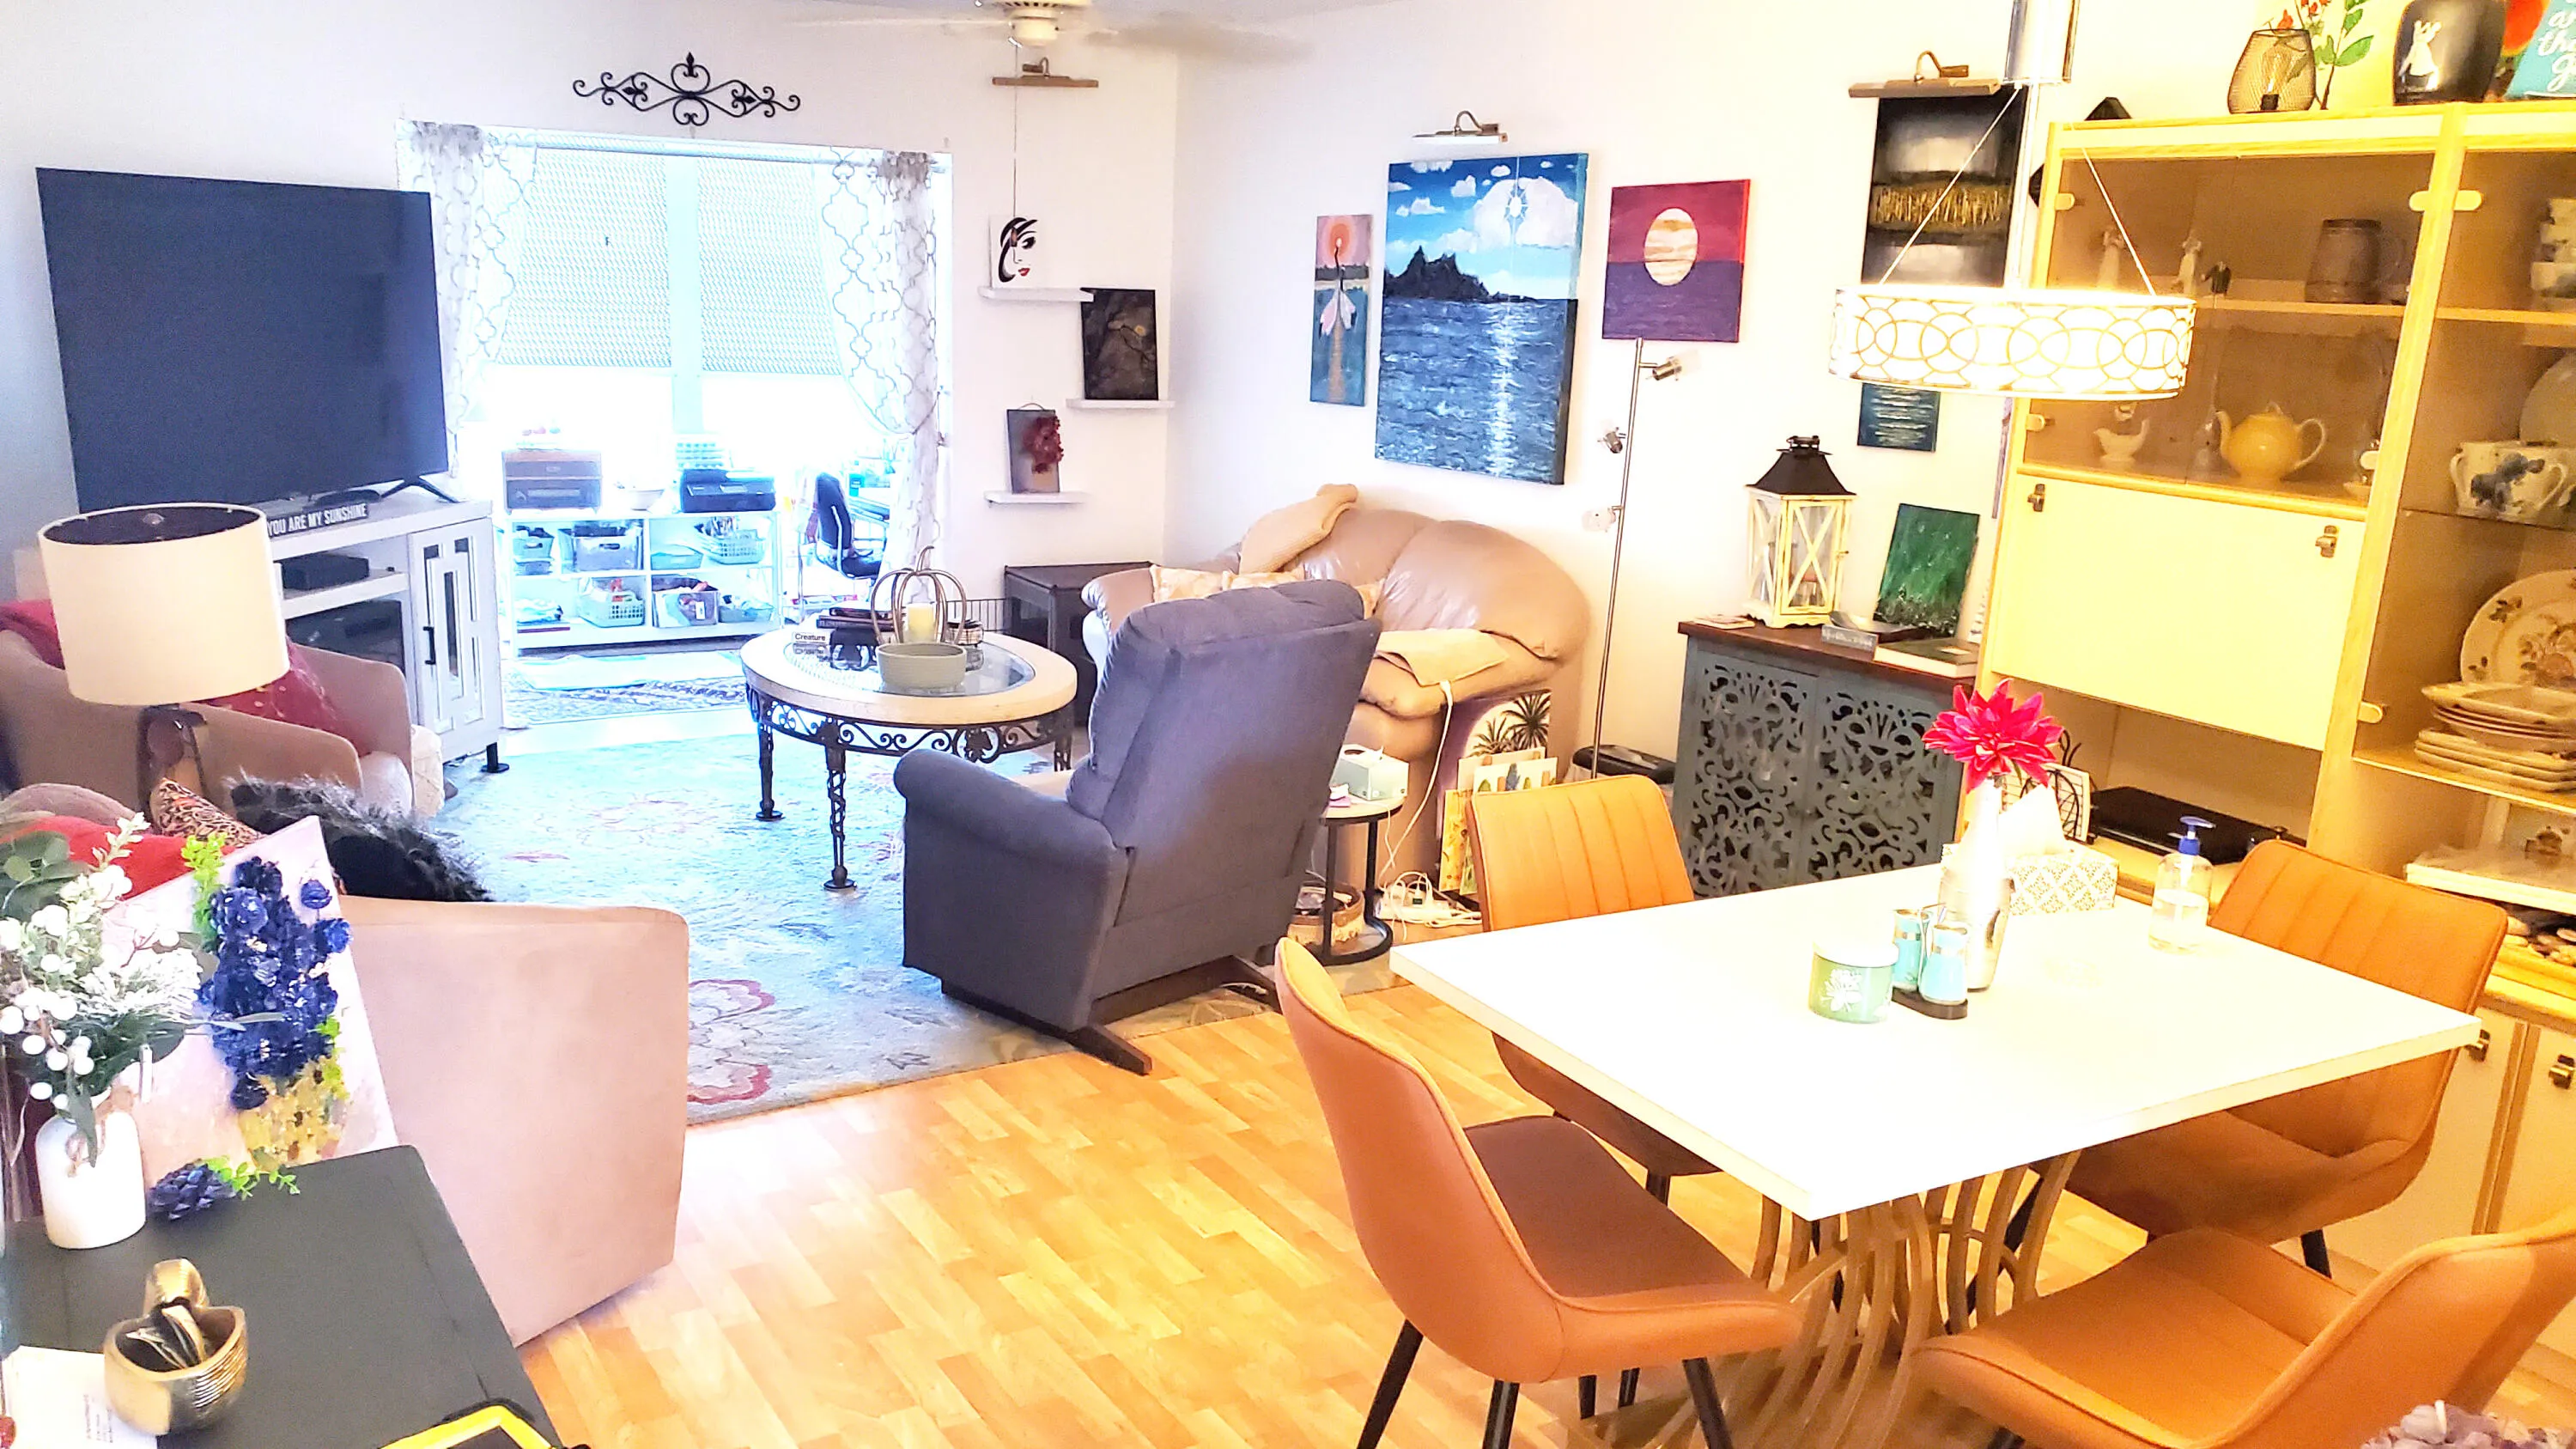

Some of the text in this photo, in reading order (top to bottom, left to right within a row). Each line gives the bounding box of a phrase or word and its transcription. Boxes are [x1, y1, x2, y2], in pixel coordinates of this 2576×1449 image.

[267, 503, 367, 536] YOU ARE MY SUNSHINE
[794, 633, 826, 642] Creature
